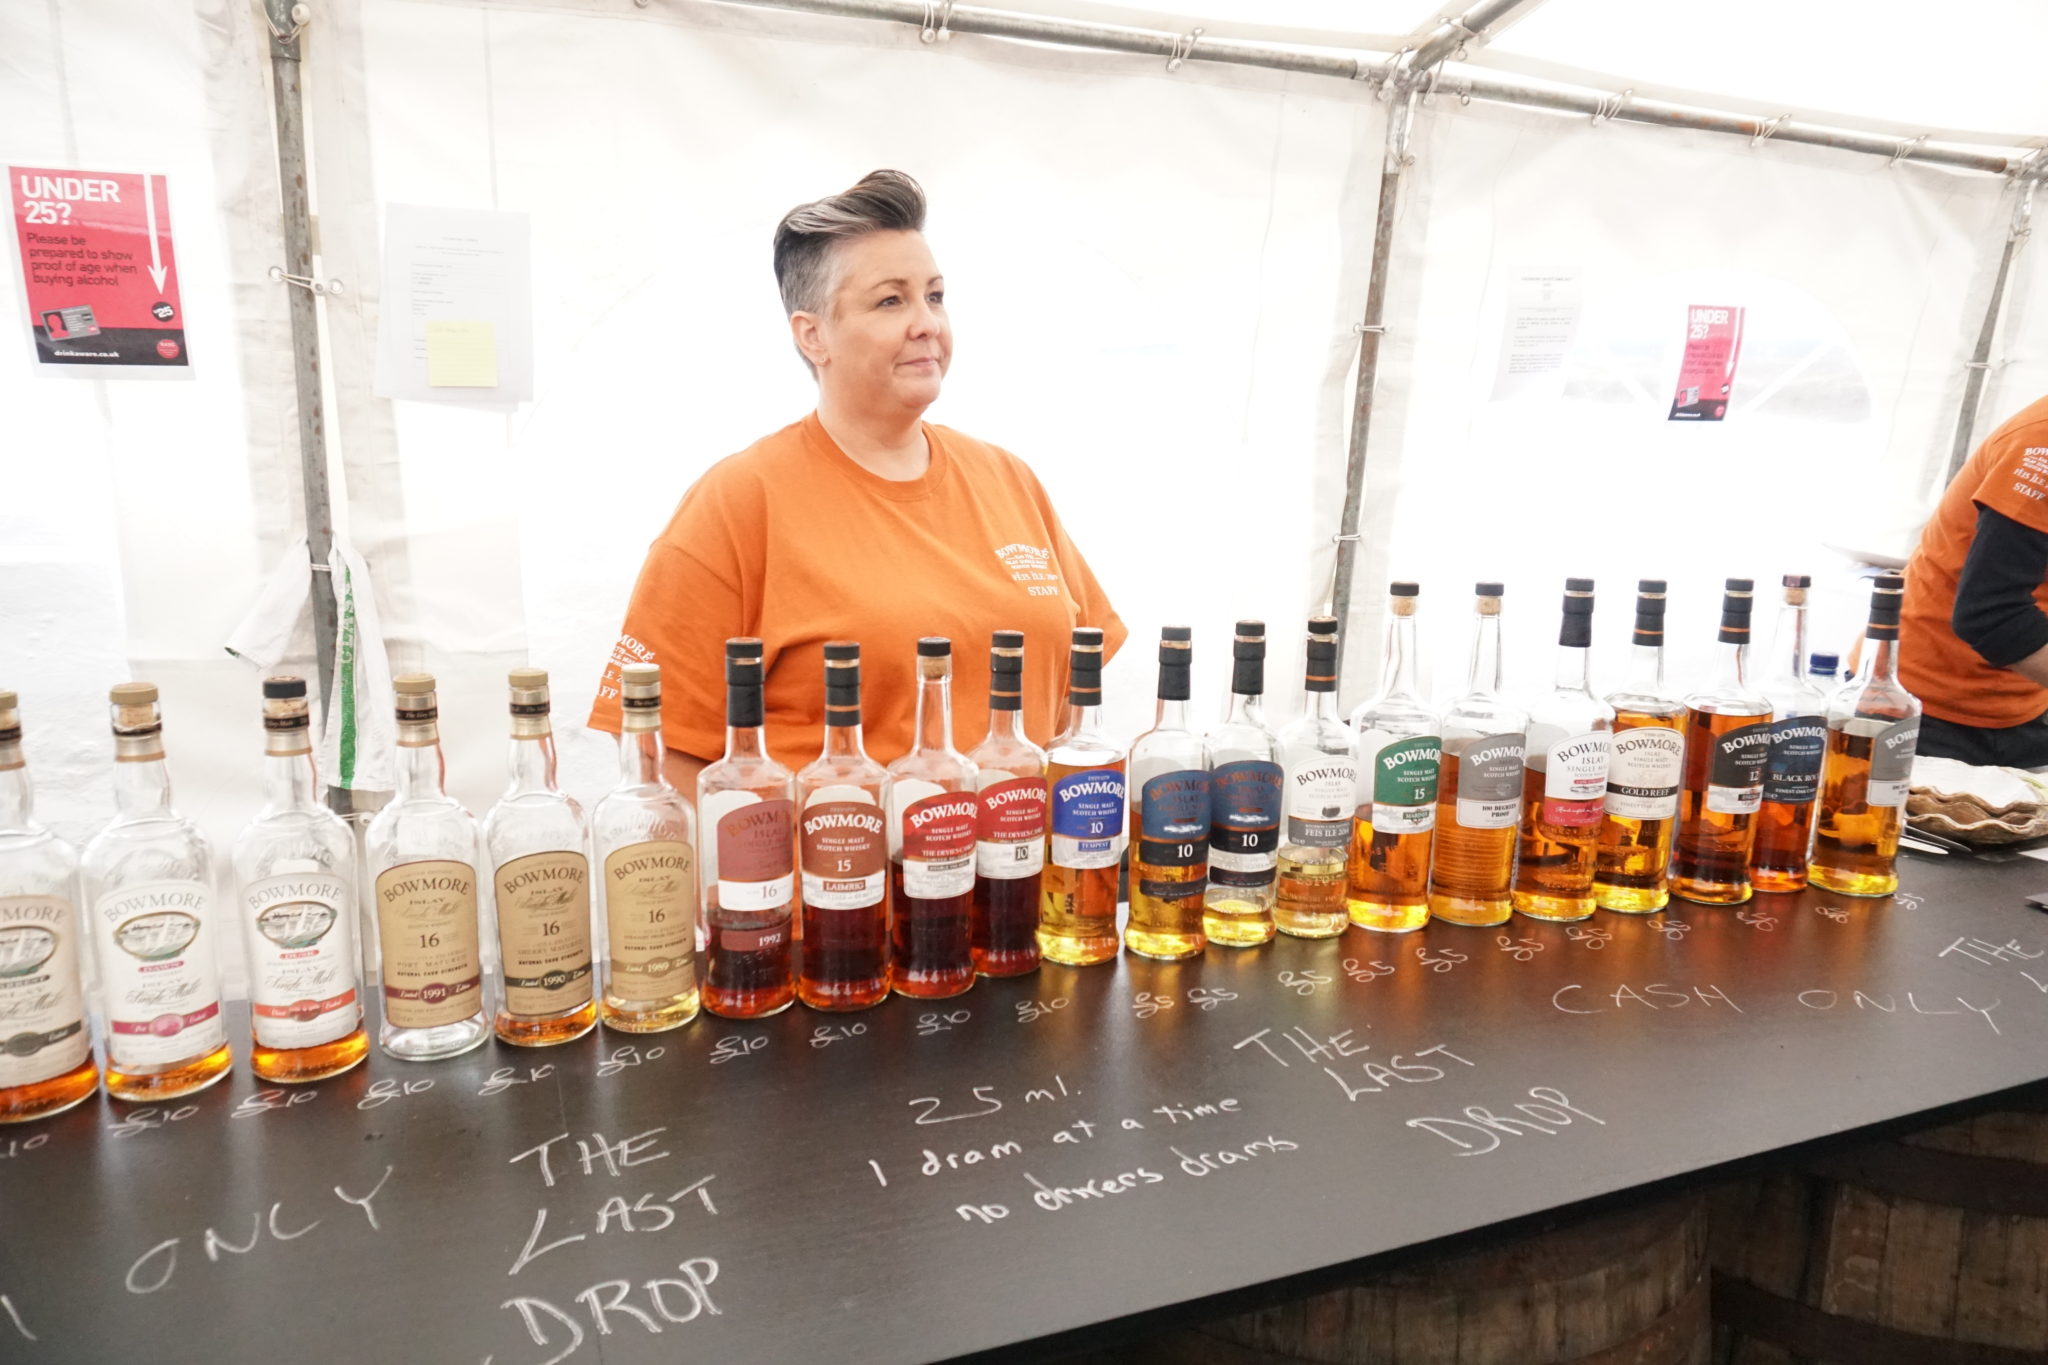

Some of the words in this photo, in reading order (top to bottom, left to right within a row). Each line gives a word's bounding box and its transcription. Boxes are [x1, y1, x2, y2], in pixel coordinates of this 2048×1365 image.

[21, 175, 120, 202] UNDER
[23, 201, 72, 225] 25?
[27, 232, 68, 245] Please
[71, 236, 86, 245] be
[29, 248, 84, 260] prepared
[87, 250, 98, 259] to
[101, 250, 133, 260] show
[31, 261, 62, 273] proof
[65, 262, 76, 271] of
[80, 264, 101, 274] age
[104, 264, 137, 274] when
[33, 273, 74, 287] buying
[77, 274, 119, 286] alcohol
[1690, 309, 1729, 325] UNDER
[1689, 324, 1709, 340] 25?
[54, 350, 120, 358] drinkaware.co.uk
[2013, 482, 2046, 500] STAFF
[1616, 739, 1681, 757] BOWMORE
[1773, 774, 1803, 782] BLACK
[1059, 781, 1125, 802] BOWMORE
[1414, 788, 1425, 800] 15
[1621, 787, 1649, 796] GOLD
[1650, 788, 1670, 796] REEF
[1072, 809, 1097, 817] SCOTCH
[804, 814, 883, 835] BOWMORE
[1090, 822, 1104, 834] 10
[816, 844, 843, 852] SCOTCH
[1242, 833, 1259, 847] 10
[1016, 847, 1028, 860] 10
[1177, 844, 1193, 858] 10
[614, 856, 691, 881] BOWMORE
[837, 860, 852, 872] 15
[384, 877, 470, 902] BOWMORE
[504, 867, 585, 894] BOWMORE
[248, 883, 343, 910] BOWMORE
[761, 884, 778, 899] 16
[104, 892, 204, 923] BOWMORE
[649, 908, 665, 923] 16
[542, 921, 560, 937] 16
[758, 932, 781, 947] 1992
[419, 932, 440, 949] 16
[1938, 937, 2046, 966] THE
[543, 974, 567, 987] 1990
[423, 987, 447, 1000] 1991
[1015, 997, 1070, 1023] £10
[1132, 991, 1176, 1019] £5
[1553, 984, 1744, 1014] CASH
[1798, 989, 2001, 1035] ONLY
[916, 1009, 971, 1036] £10
[810, 1022, 868, 1049] £10
[709, 1035, 769, 1065] £10
[1234, 1025, 1371, 1068] THE
[597, 1045, 666, 1077] £10
[1324, 1044, 1476, 1102] LAST
[357, 1079, 436, 1110] £10
[909, 1086, 1003, 1125] 25
[1406, 1087, 1606, 1157] DROP
[0, 1134, 49, 1158] 10
[868, 1159, 888, 1187] 1
[921, 1140, 1023, 1176] dram
[1052, 1119, 1097, 1145] at
[1121, 1117, 1143, 1130] a
[1153, 1098, 1241, 1123] time
[508, 1126, 671, 1186] THE
[955, 1203, 1010, 1224] no
[1170, 1136, 1299, 1176] drams
[126, 1165, 392, 1294] ONLY
[508, 1174, 718, 1275] LAST
[500, 1257, 723, 1365] DROP
